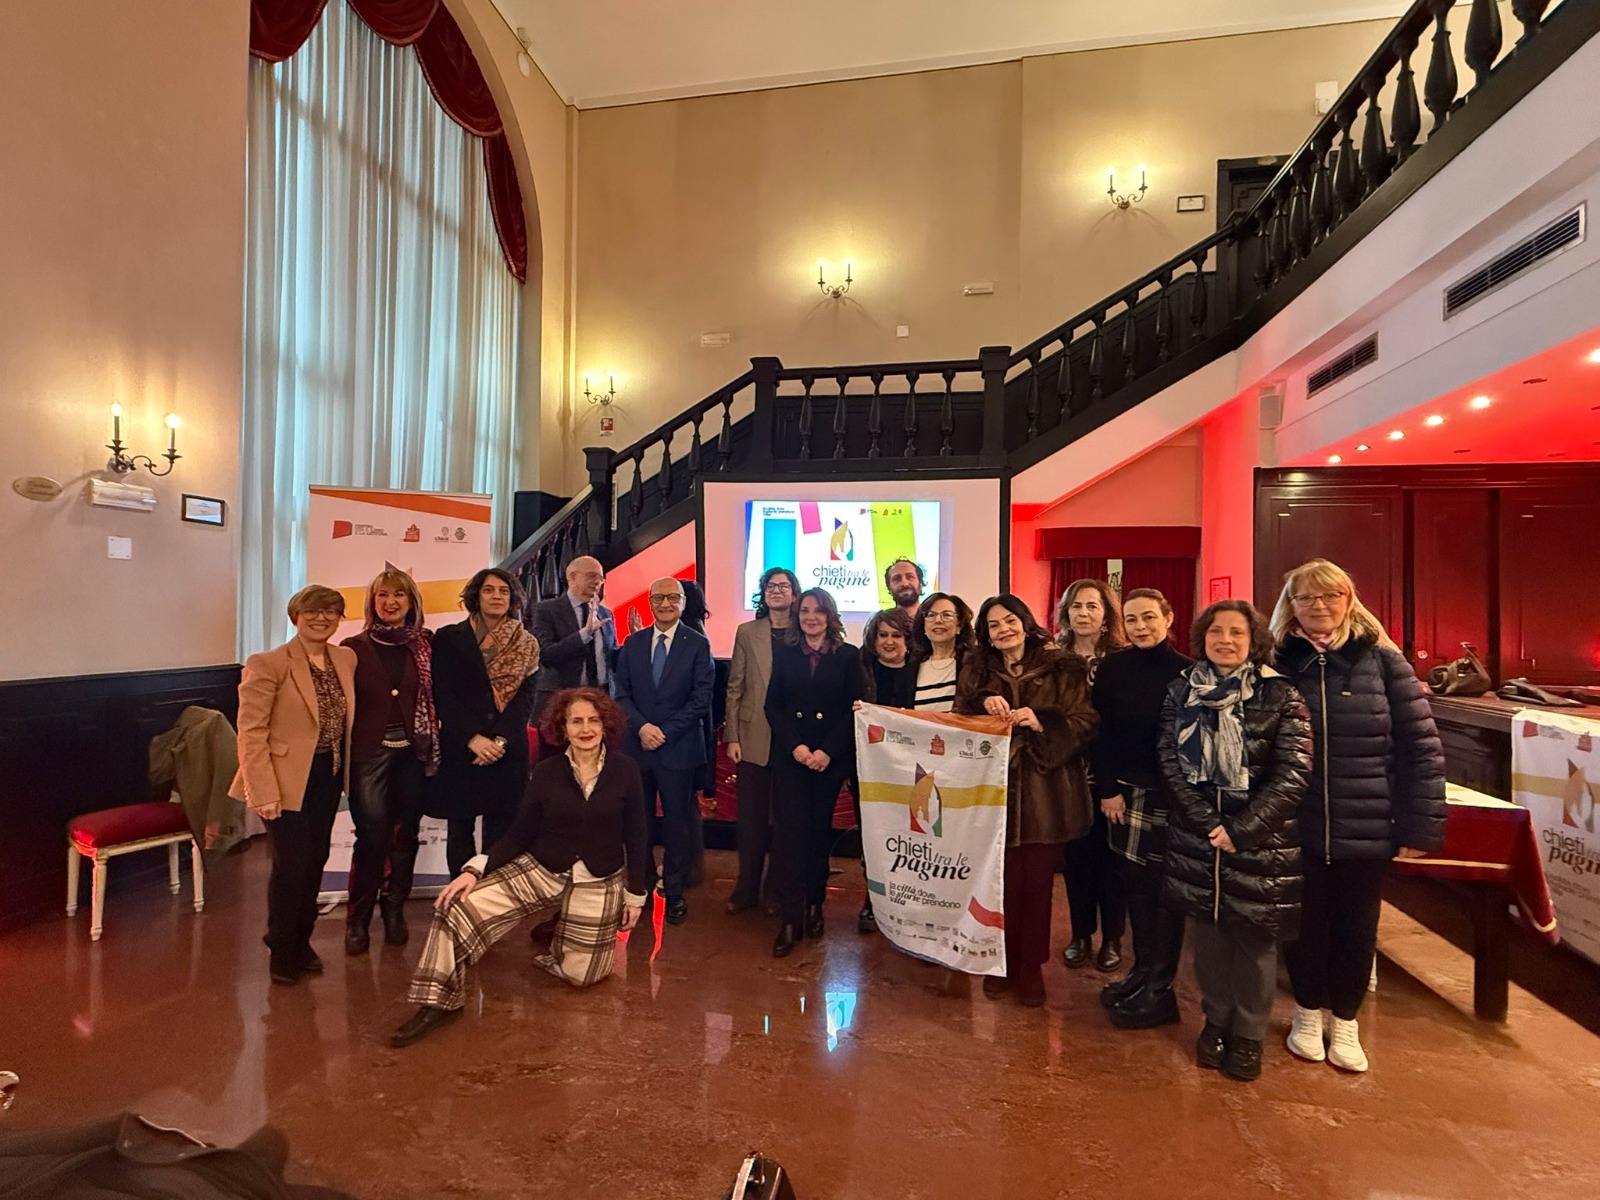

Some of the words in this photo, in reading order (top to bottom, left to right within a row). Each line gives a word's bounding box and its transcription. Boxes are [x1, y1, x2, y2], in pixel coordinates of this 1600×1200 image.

[812, 564, 846, 577] chieti
[819, 575, 871, 590] pagine
[886, 834, 932, 861] chieti
[933, 852, 952, 866] tra
[955, 852, 969, 866] le
[1543, 828, 1584, 855] chieti
[890, 853, 971, 881] pagine
[896, 883, 916, 894] città
[917, 888, 936, 900] dove
[921, 897, 961, 909] prendono
